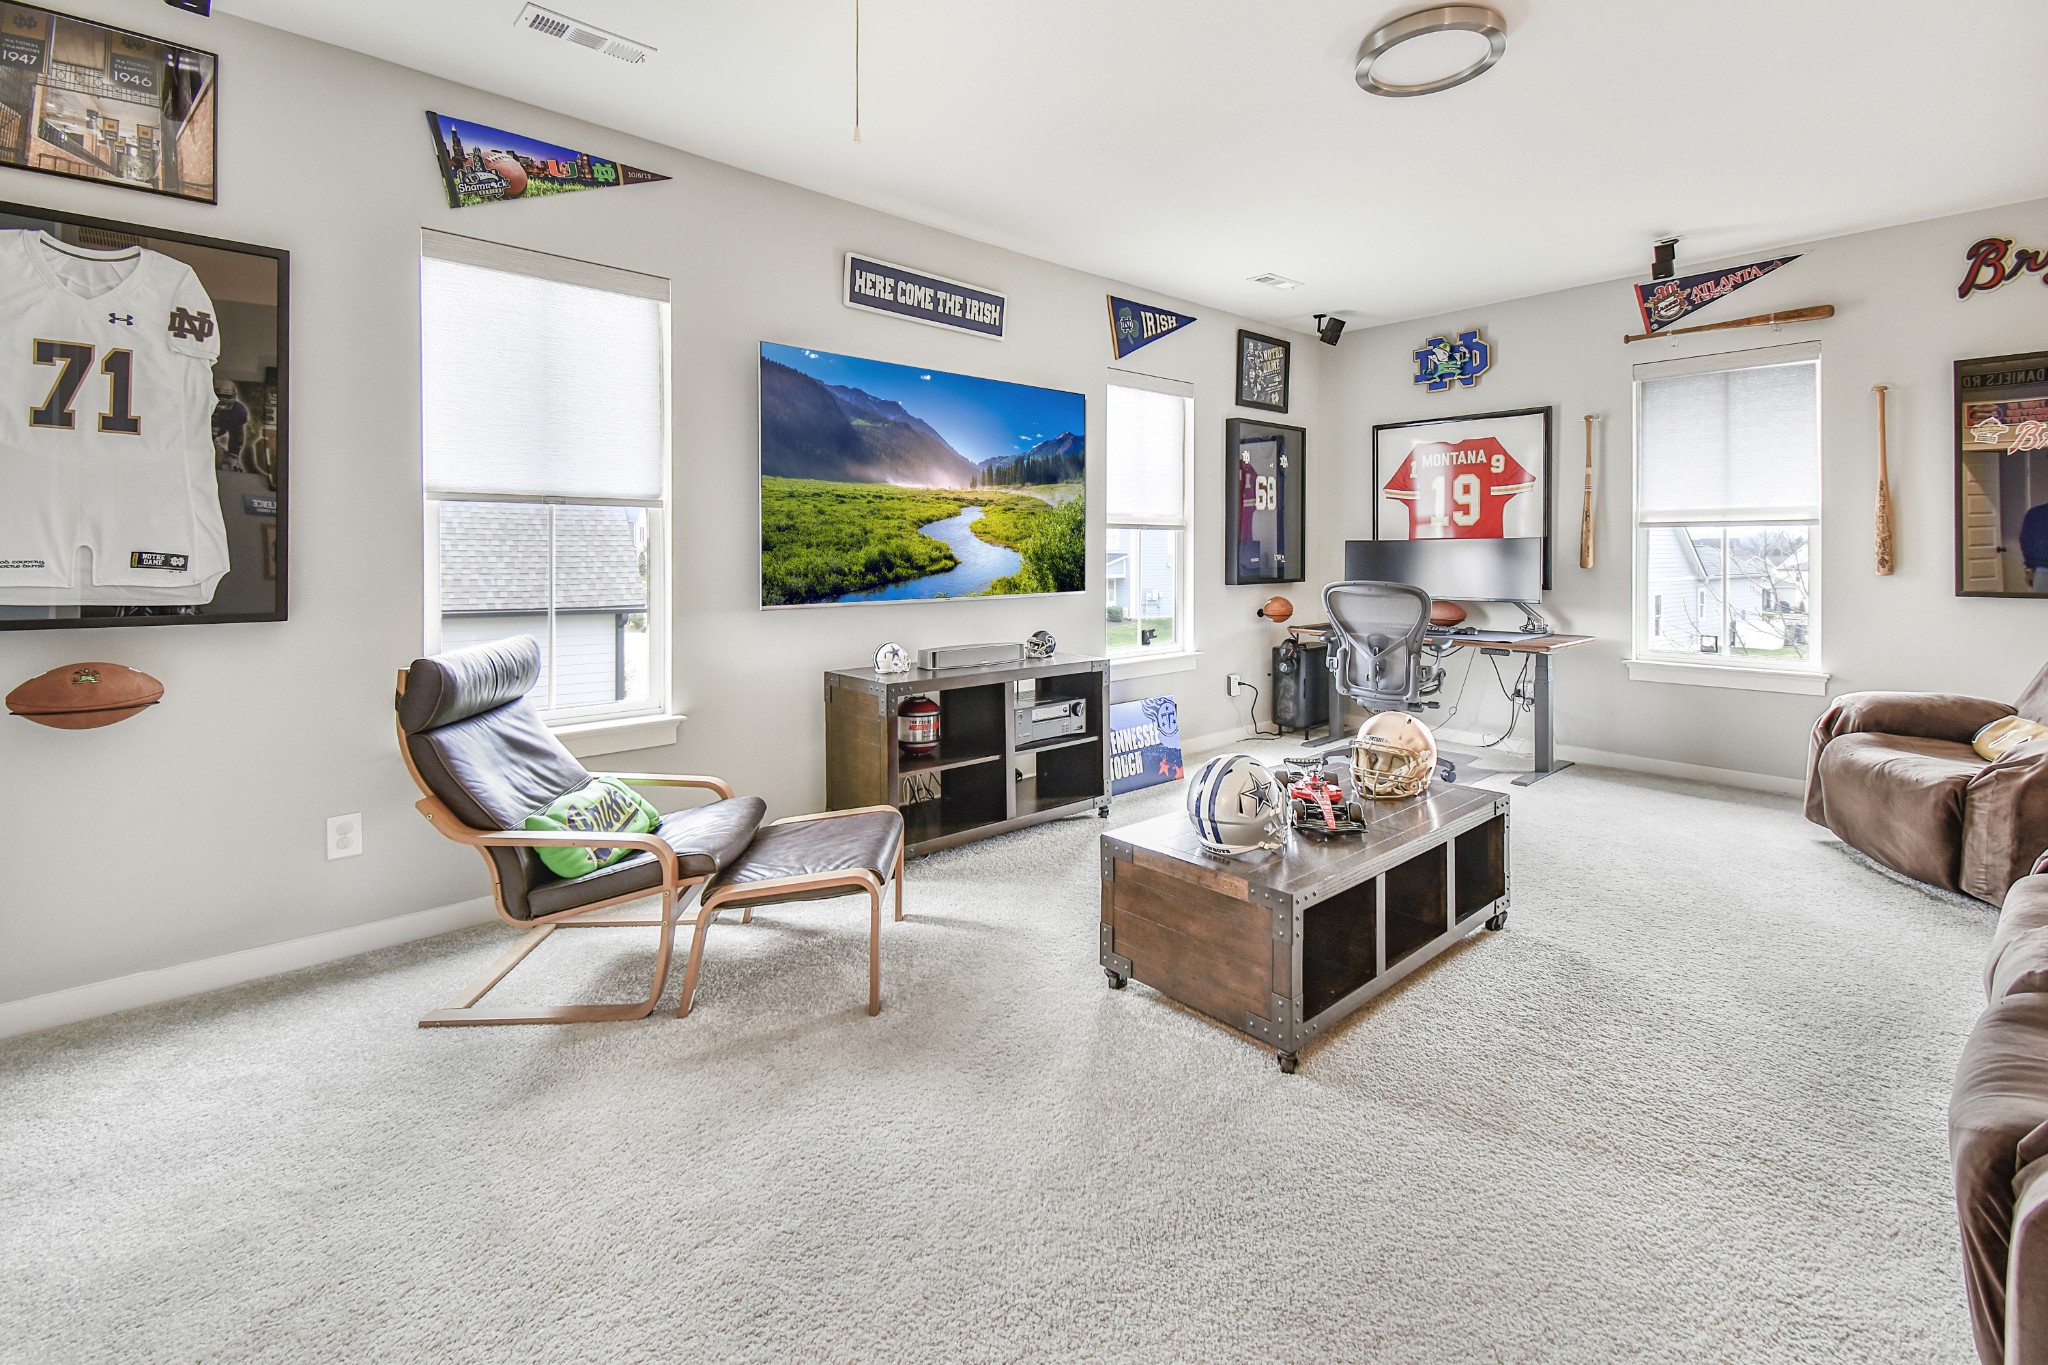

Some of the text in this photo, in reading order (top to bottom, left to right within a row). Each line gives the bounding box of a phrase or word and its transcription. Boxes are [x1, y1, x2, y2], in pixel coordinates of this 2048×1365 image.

[2, 43, 41, 54] CHAMPIONS
[4, 38, 39, 48] NATIONAL
[2, 50, 37, 65] 1947
[116, 59, 150, 69] NATIONAL
[114, 63, 152, 75] CHAMPIONS
[114, 71, 152, 87] 1946
[1690, 265, 1763, 300] ATLANTA
[854, 269, 1001, 327] HERE COME THE IRISH
[1140, 310, 1177, 339] IRISH
[1262, 346, 1284, 361] NOTRE
[1262, 359, 1281, 373] DAME
[29, 337, 142, 436] 71
[1422, 449, 1487, 468] MONTANA
[1490, 454, 1506, 474] 9
[1255, 475, 1277, 511] 68
[1430, 473, 1481, 527] 19
[142, 553, 165, 561] NOTRE
